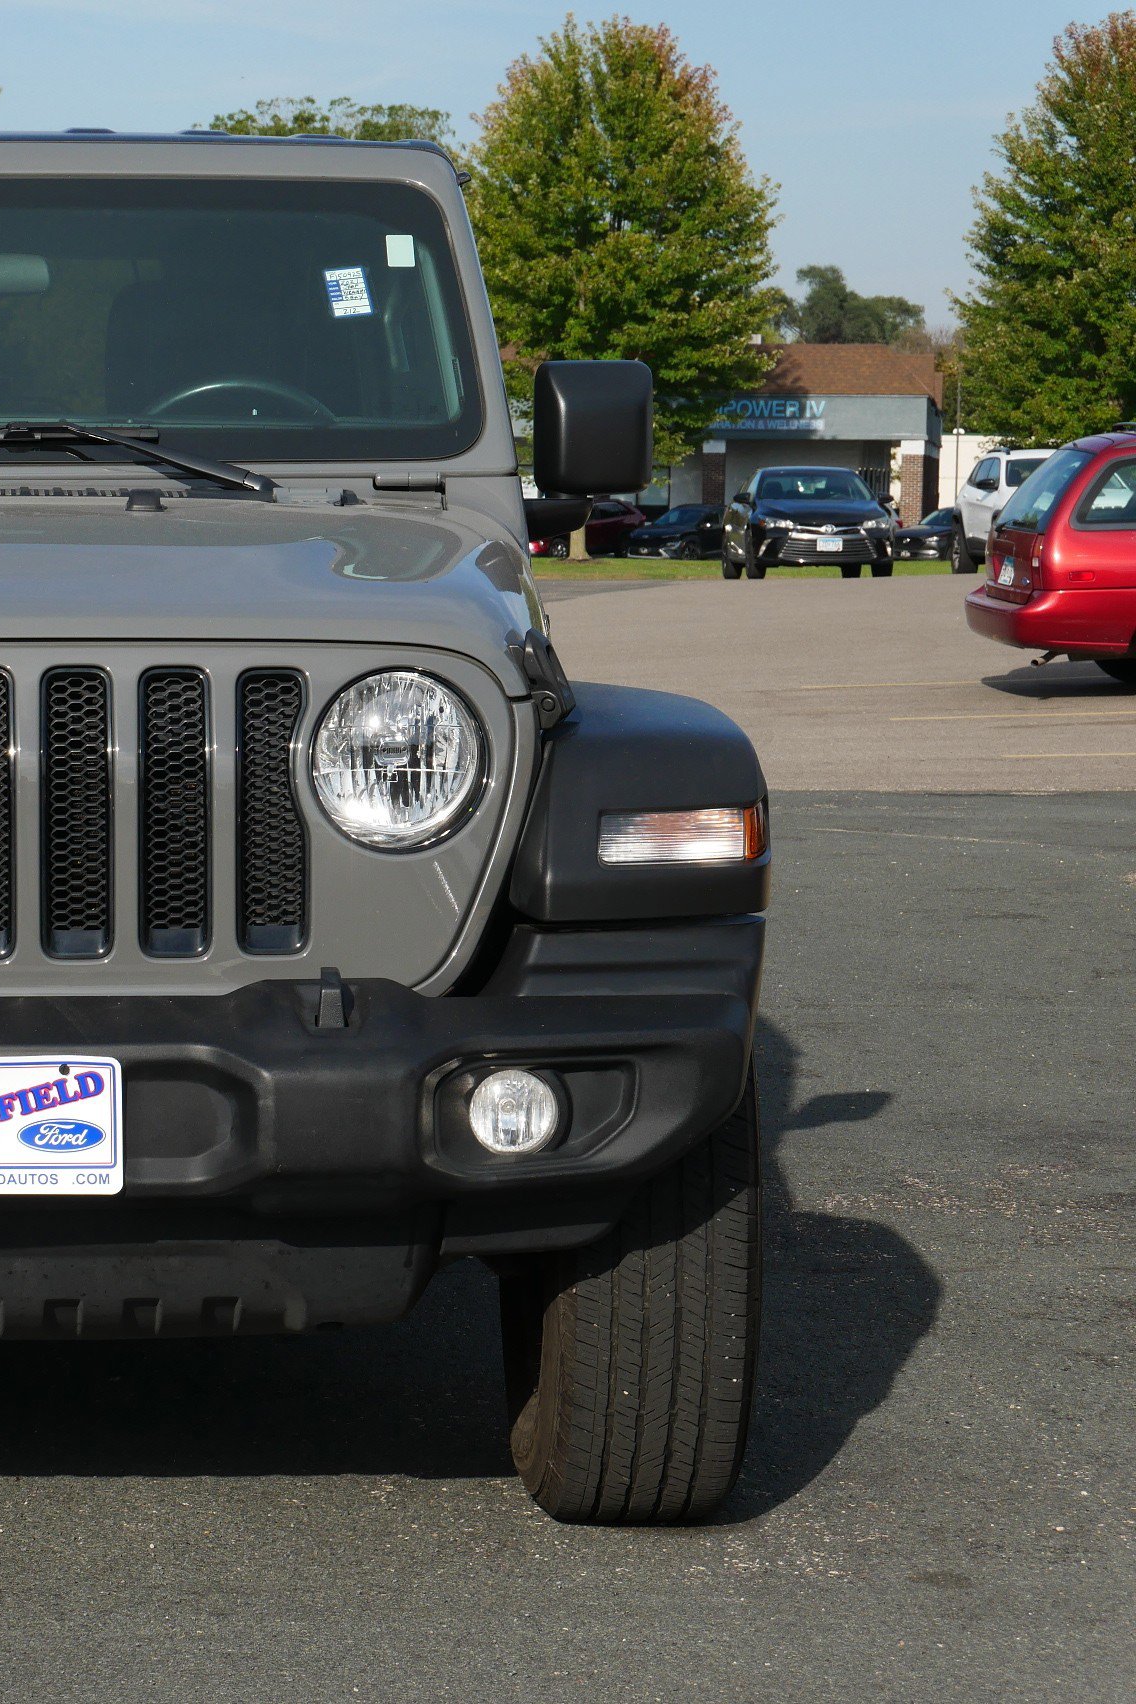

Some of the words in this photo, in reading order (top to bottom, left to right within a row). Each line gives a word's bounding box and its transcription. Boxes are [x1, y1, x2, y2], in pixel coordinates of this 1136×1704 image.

[714, 400, 800, 417] POWER
[806, 400, 826, 417] IV
[34, 1123, 88, 1147] Ford
